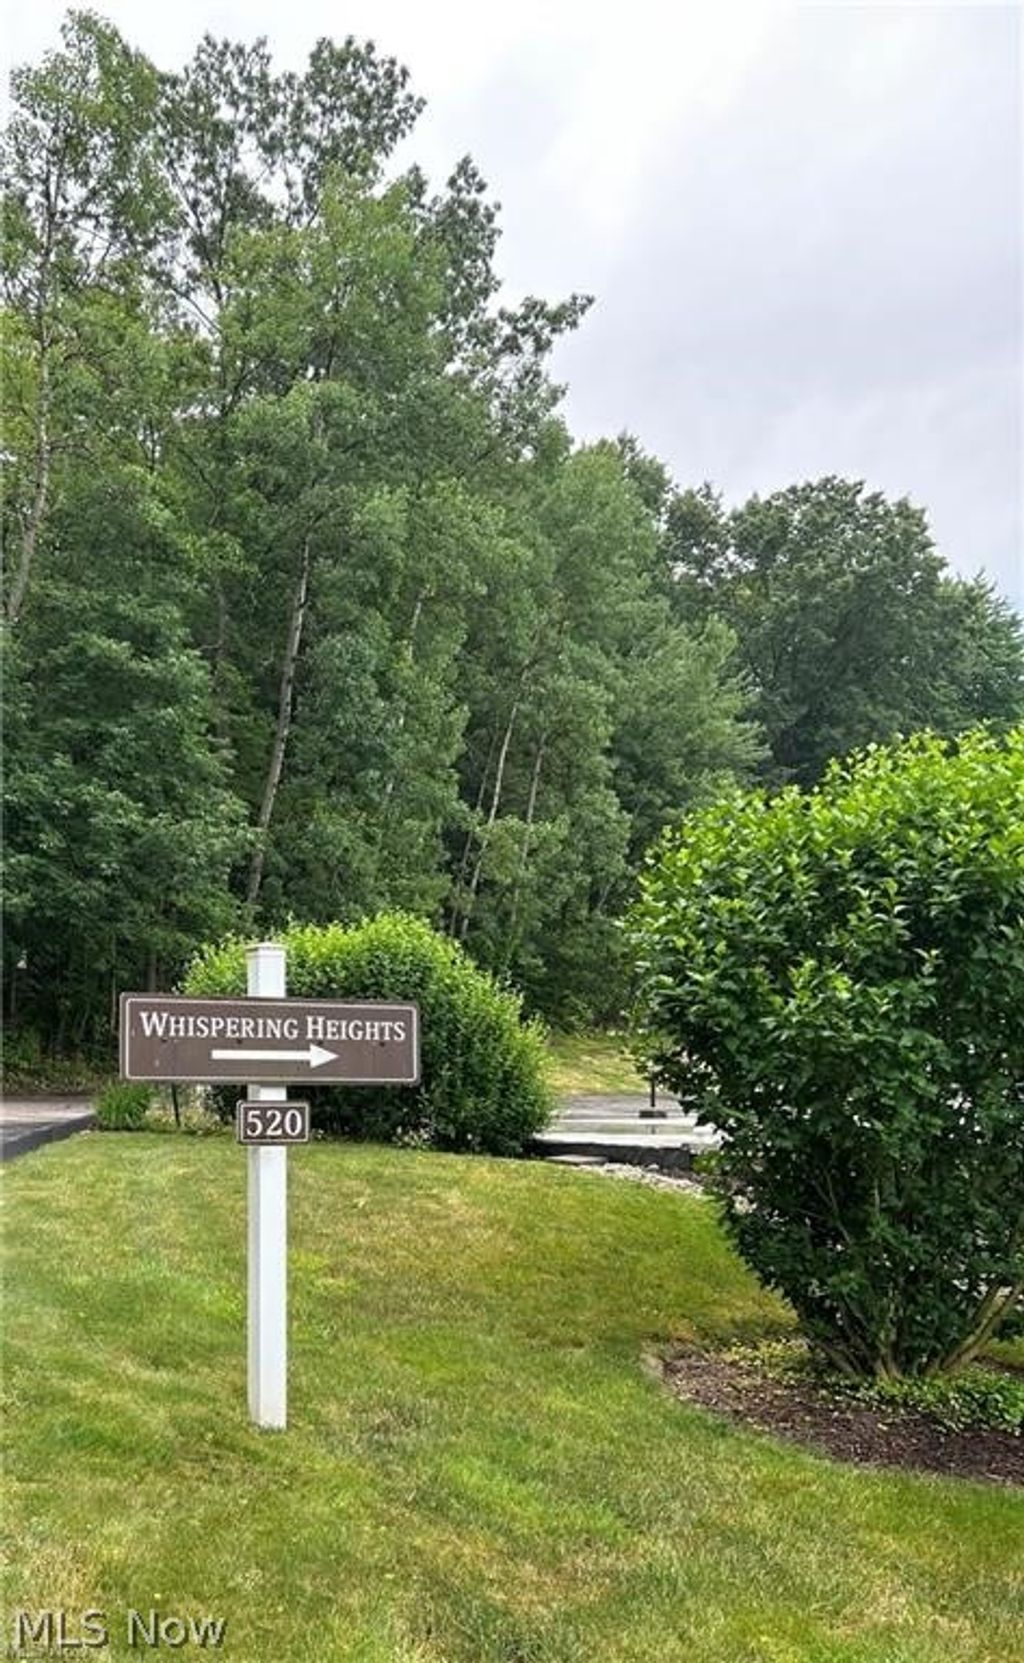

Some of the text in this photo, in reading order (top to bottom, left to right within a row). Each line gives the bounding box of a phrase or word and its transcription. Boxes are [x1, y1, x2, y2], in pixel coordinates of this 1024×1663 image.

[139, 1011, 406, 1041] WHISPERING HEIGHTS
[246, 1109, 301, 1136] 520
